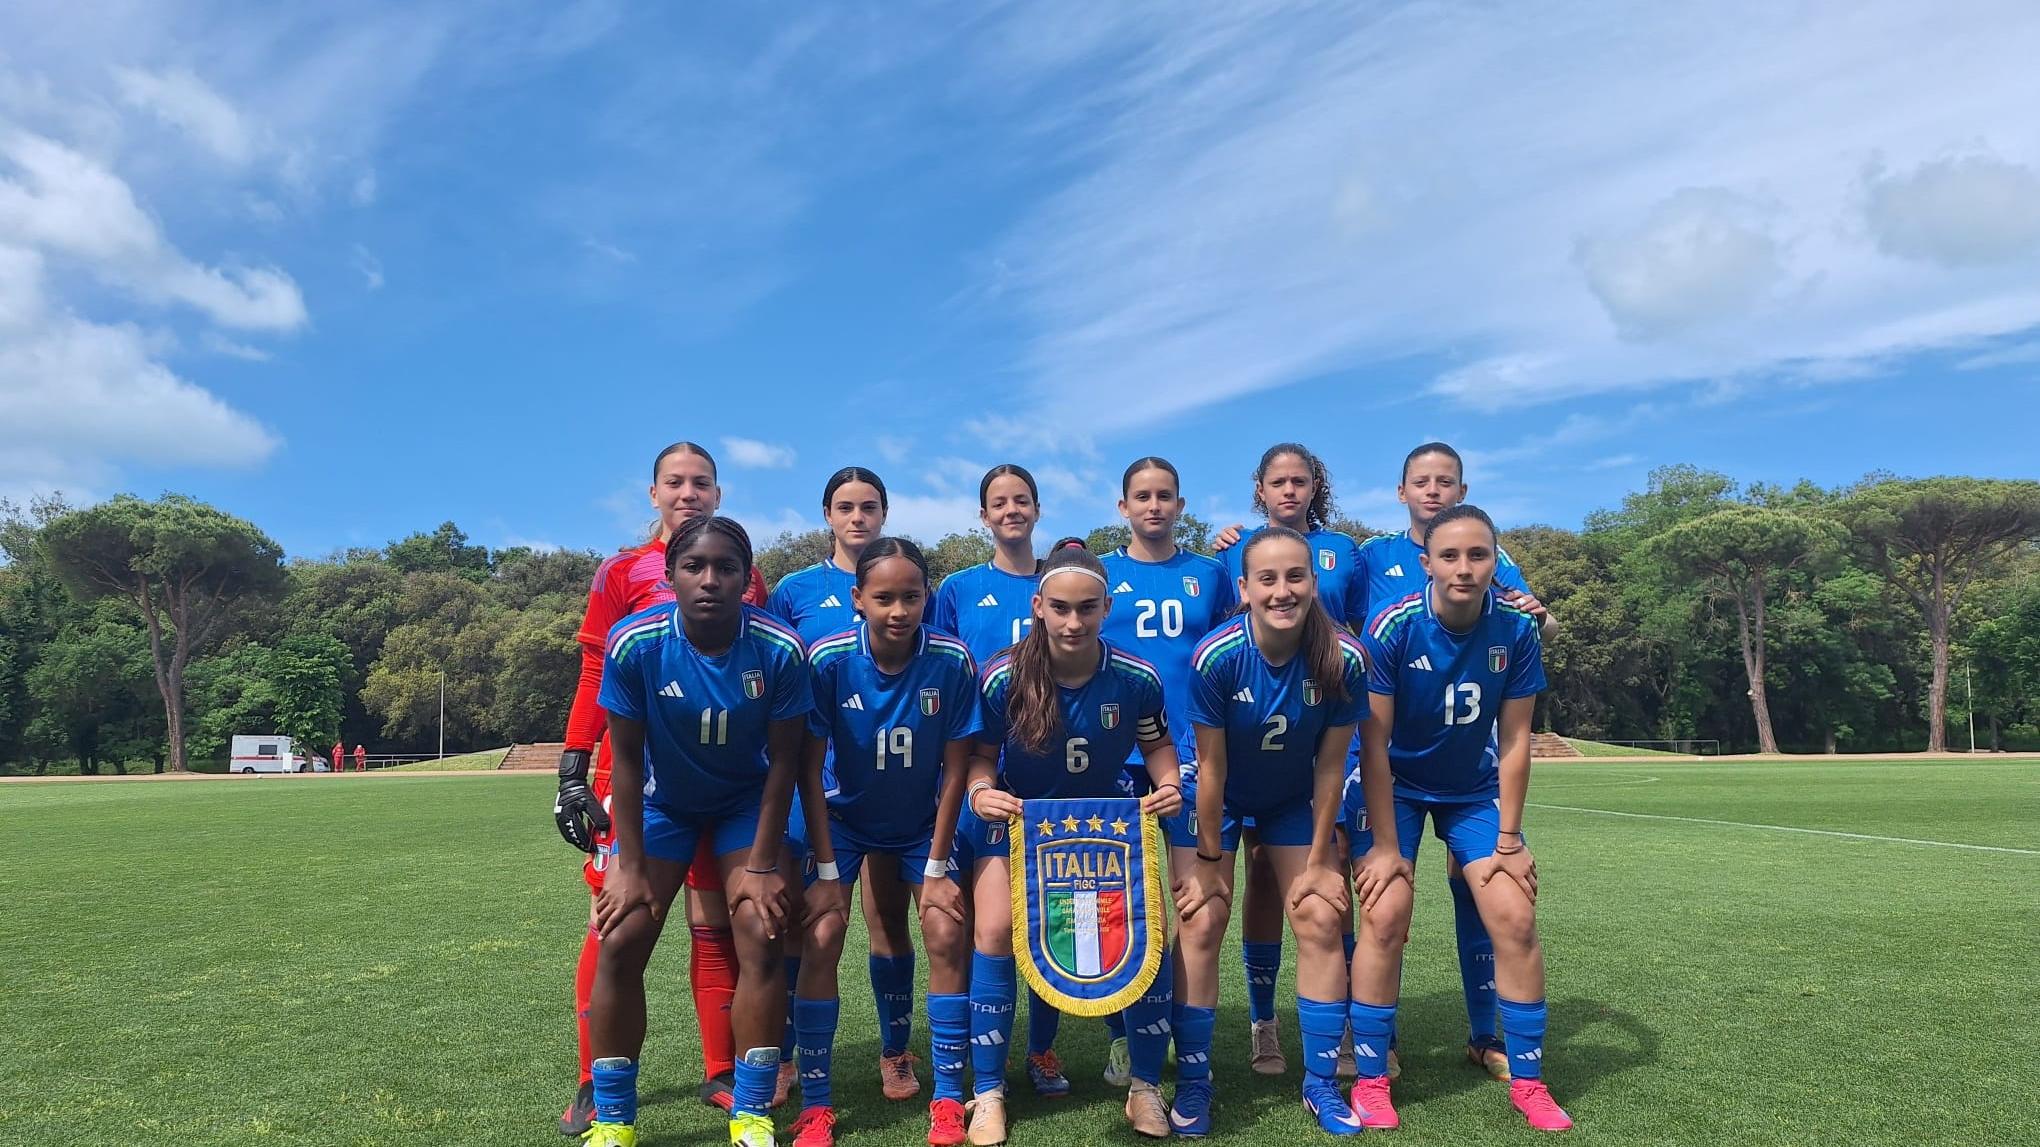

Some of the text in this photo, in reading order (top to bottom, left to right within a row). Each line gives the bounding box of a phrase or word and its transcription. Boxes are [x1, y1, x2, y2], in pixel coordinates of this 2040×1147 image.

[1135, 599, 1184, 638] 20
[743, 673, 761, 681] ITALIA
[921, 690, 938, 698] ITALIA
[1444, 682, 1482, 726] 13
[700, 707, 728, 745] 11
[1261, 714, 1287, 751] 2
[876, 726, 913, 770] 19
[1066, 737, 1089, 774] 6
[1045, 851, 1123, 879] ITALIA
[1073, 879, 1097, 891] FIGC
